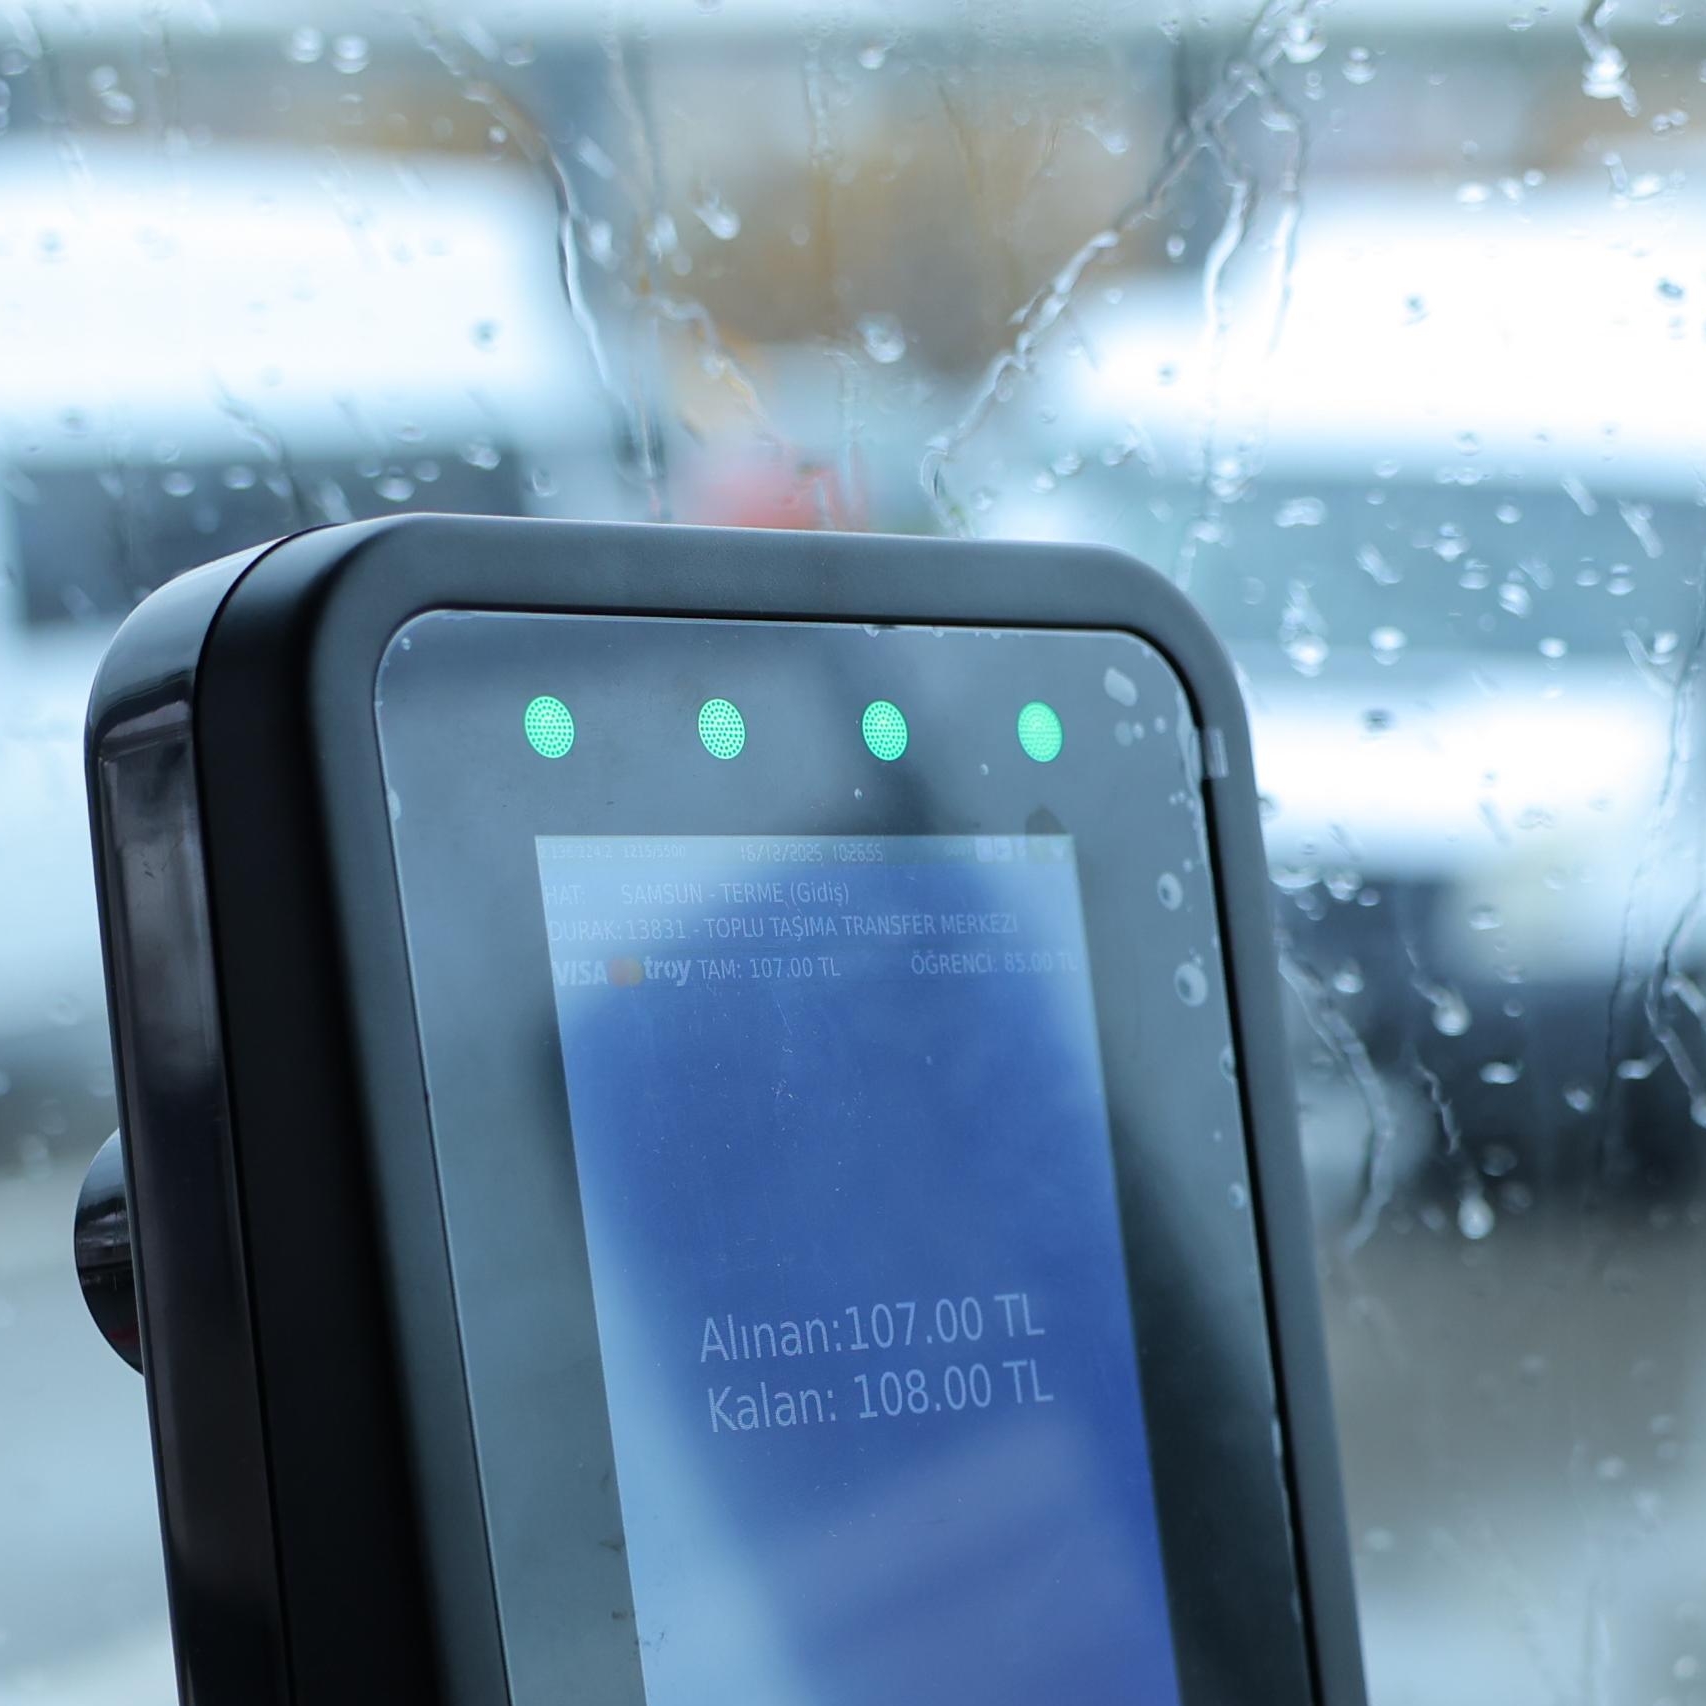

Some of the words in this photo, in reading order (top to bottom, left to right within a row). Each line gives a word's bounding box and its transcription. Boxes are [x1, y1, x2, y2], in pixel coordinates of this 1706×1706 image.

[544, 884, 586, 905] HAT:
[621, 882, 703, 905] SAMSUN
[719, 882, 785, 904] TERME
[789, 881, 850, 907] (Gidiş)
[548, 919, 623, 941] DURAK:
[628, 919, 688, 940] 13831
[703, 917, 765, 938] TOPLU
[840, 914, 937, 937] TRANSFER
[553, 958, 610, 986] VISA
[643, 956, 692, 986] troy
[697, 959, 742, 981] TAM:
[750, 957, 813, 979] 107.00
[818, 956, 842, 977] TL
[994, 1293, 1045, 1337] TL
[707, 1381, 836, 1433] Kalan:
[854, 1362, 992, 1419] 108.00
[1002, 1358, 1054, 1403] TL
